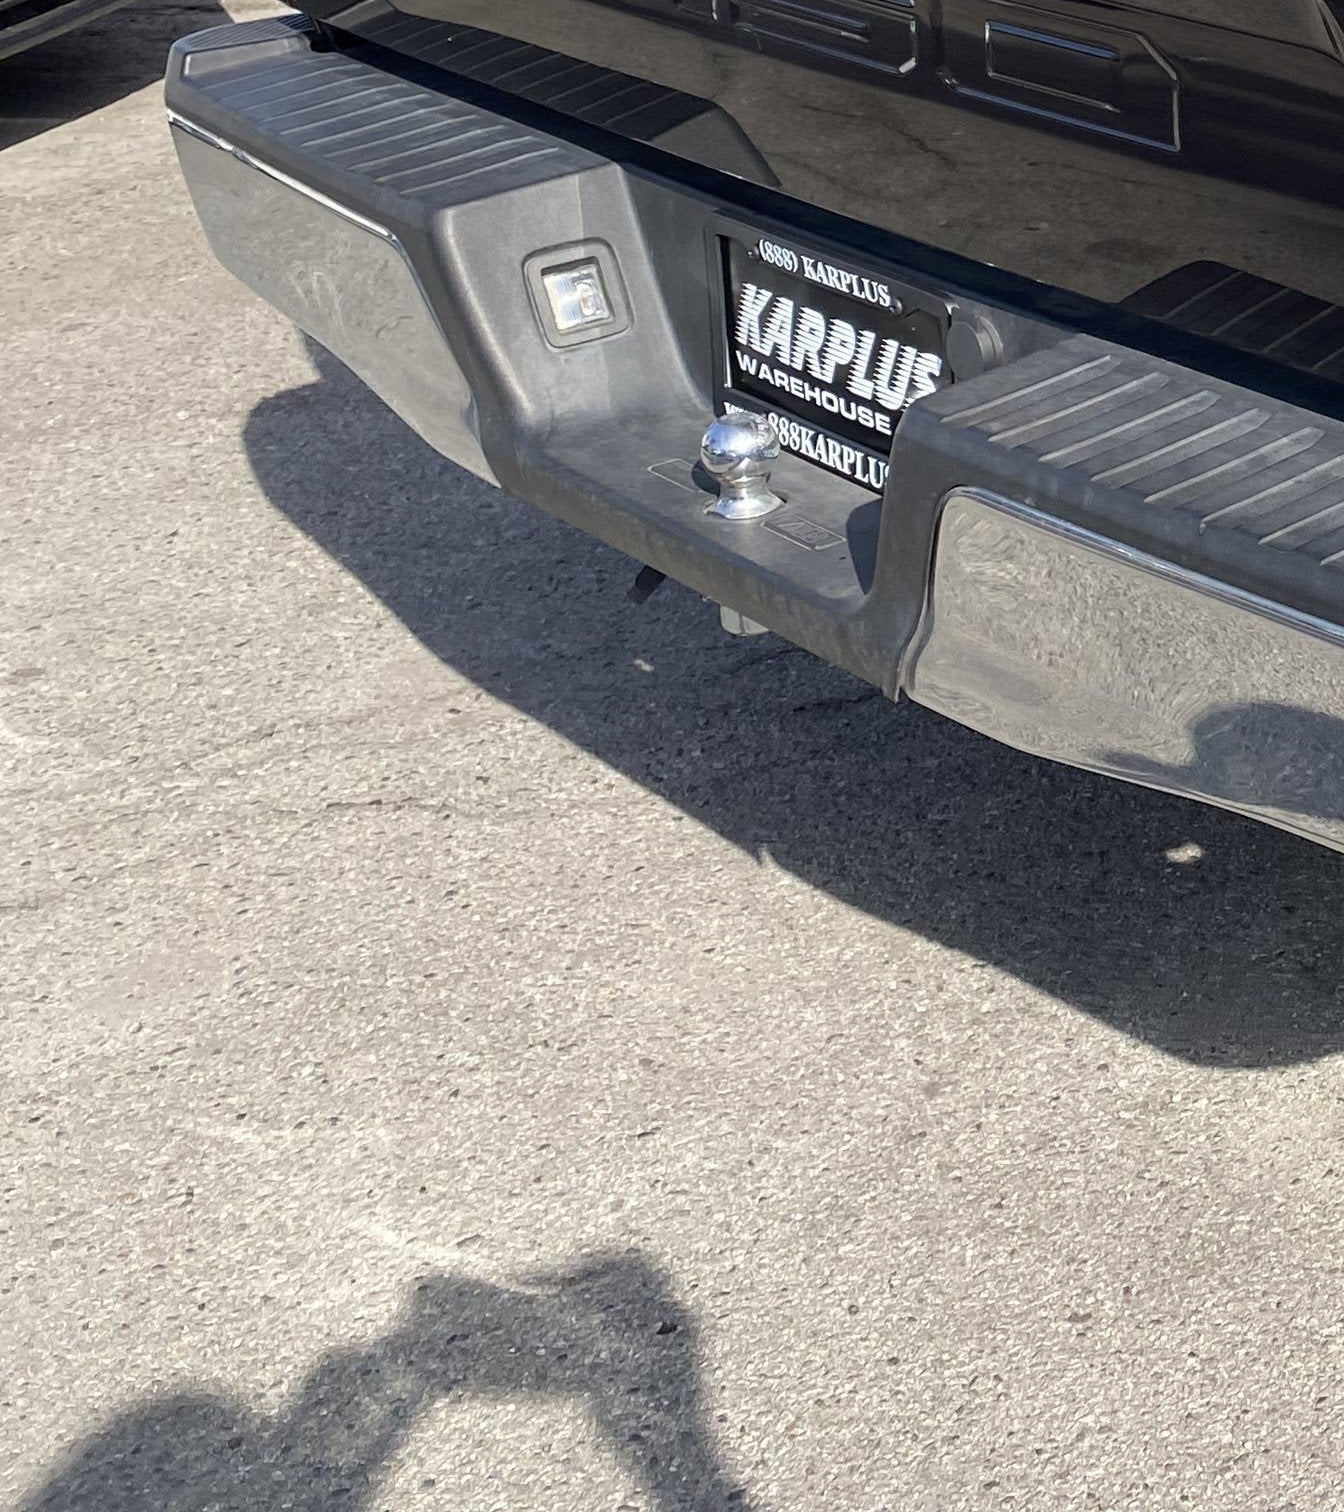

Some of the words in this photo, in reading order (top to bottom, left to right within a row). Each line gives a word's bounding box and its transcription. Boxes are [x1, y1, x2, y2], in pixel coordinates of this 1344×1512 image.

[758, 238, 799, 274] (888)
[800, 255, 890, 307] KARPLUS
[735, 282, 943, 410] KARPLUS
[735, 350, 893, 436] WAREHOUSE
